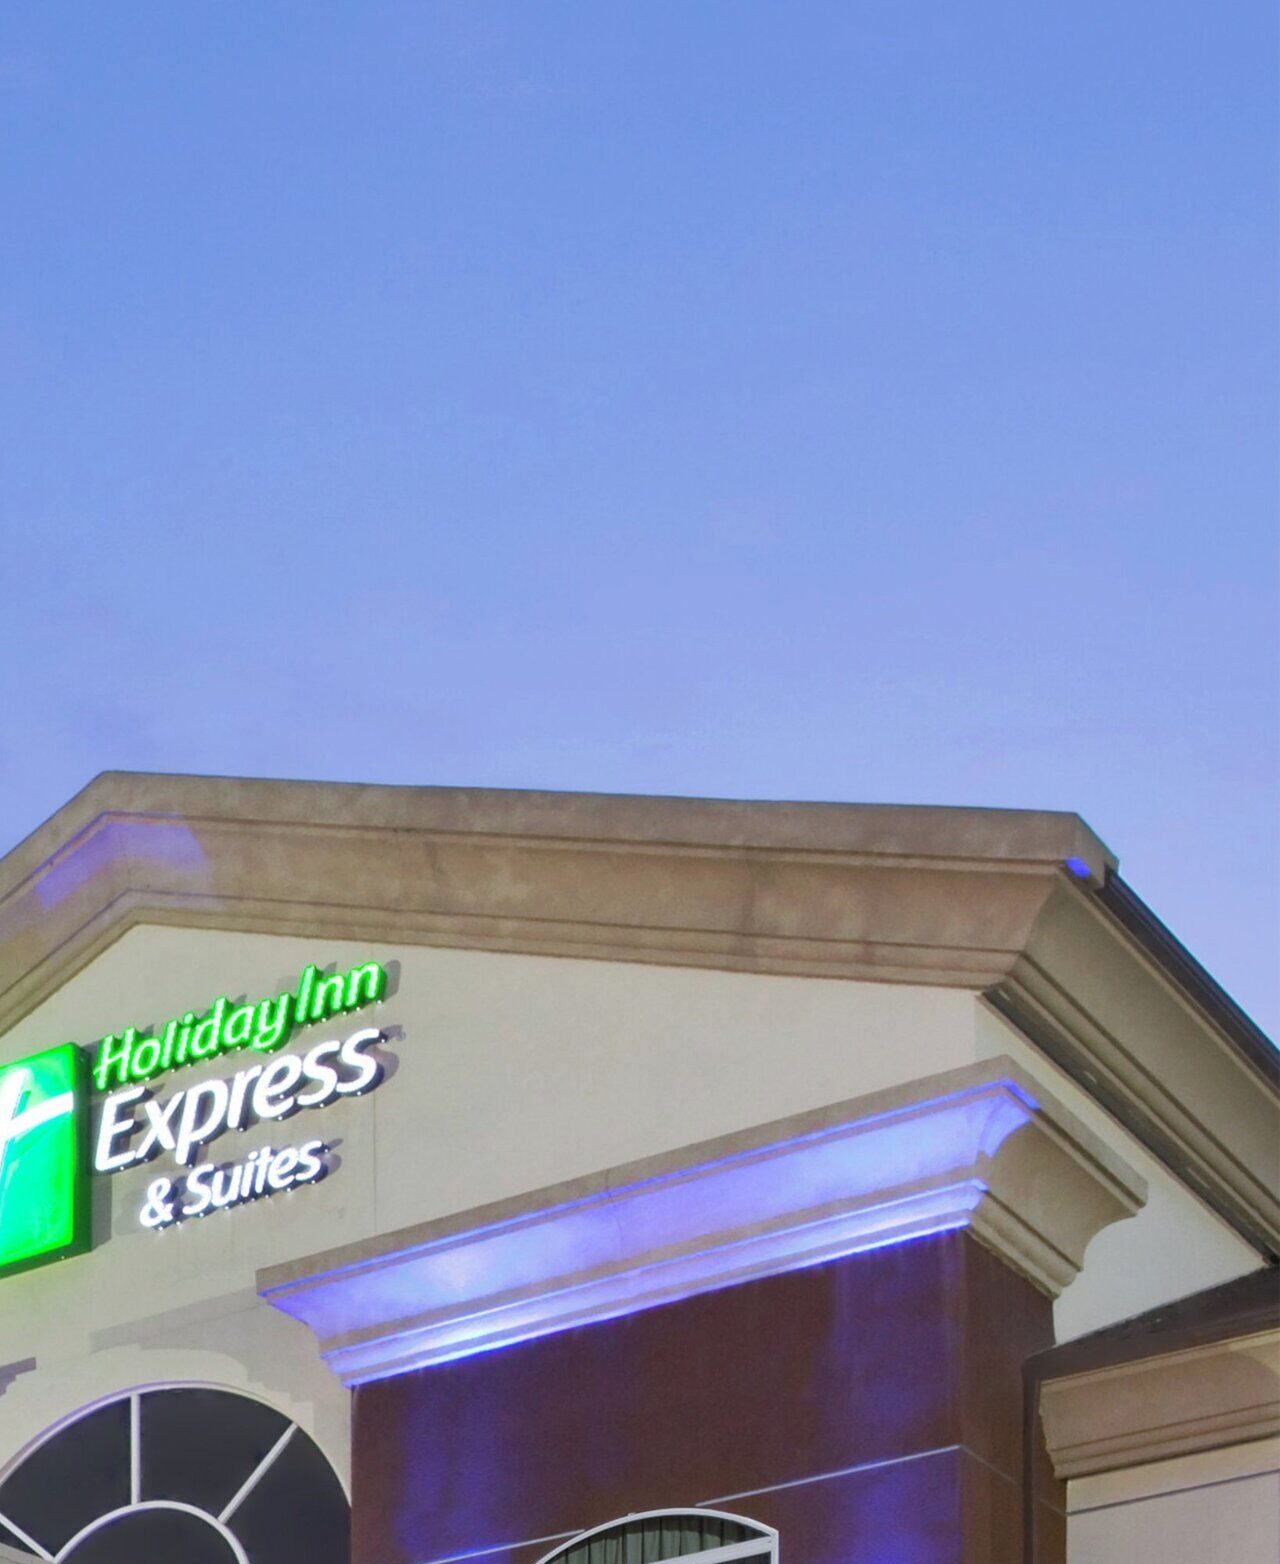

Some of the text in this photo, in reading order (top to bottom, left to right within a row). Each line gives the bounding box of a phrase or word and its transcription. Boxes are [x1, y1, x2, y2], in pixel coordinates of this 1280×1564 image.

[93, 960, 387, 1090] Holiday Inn
[94, 1028, 386, 1170] Express
[139, 1139, 328, 1229] & Suites
